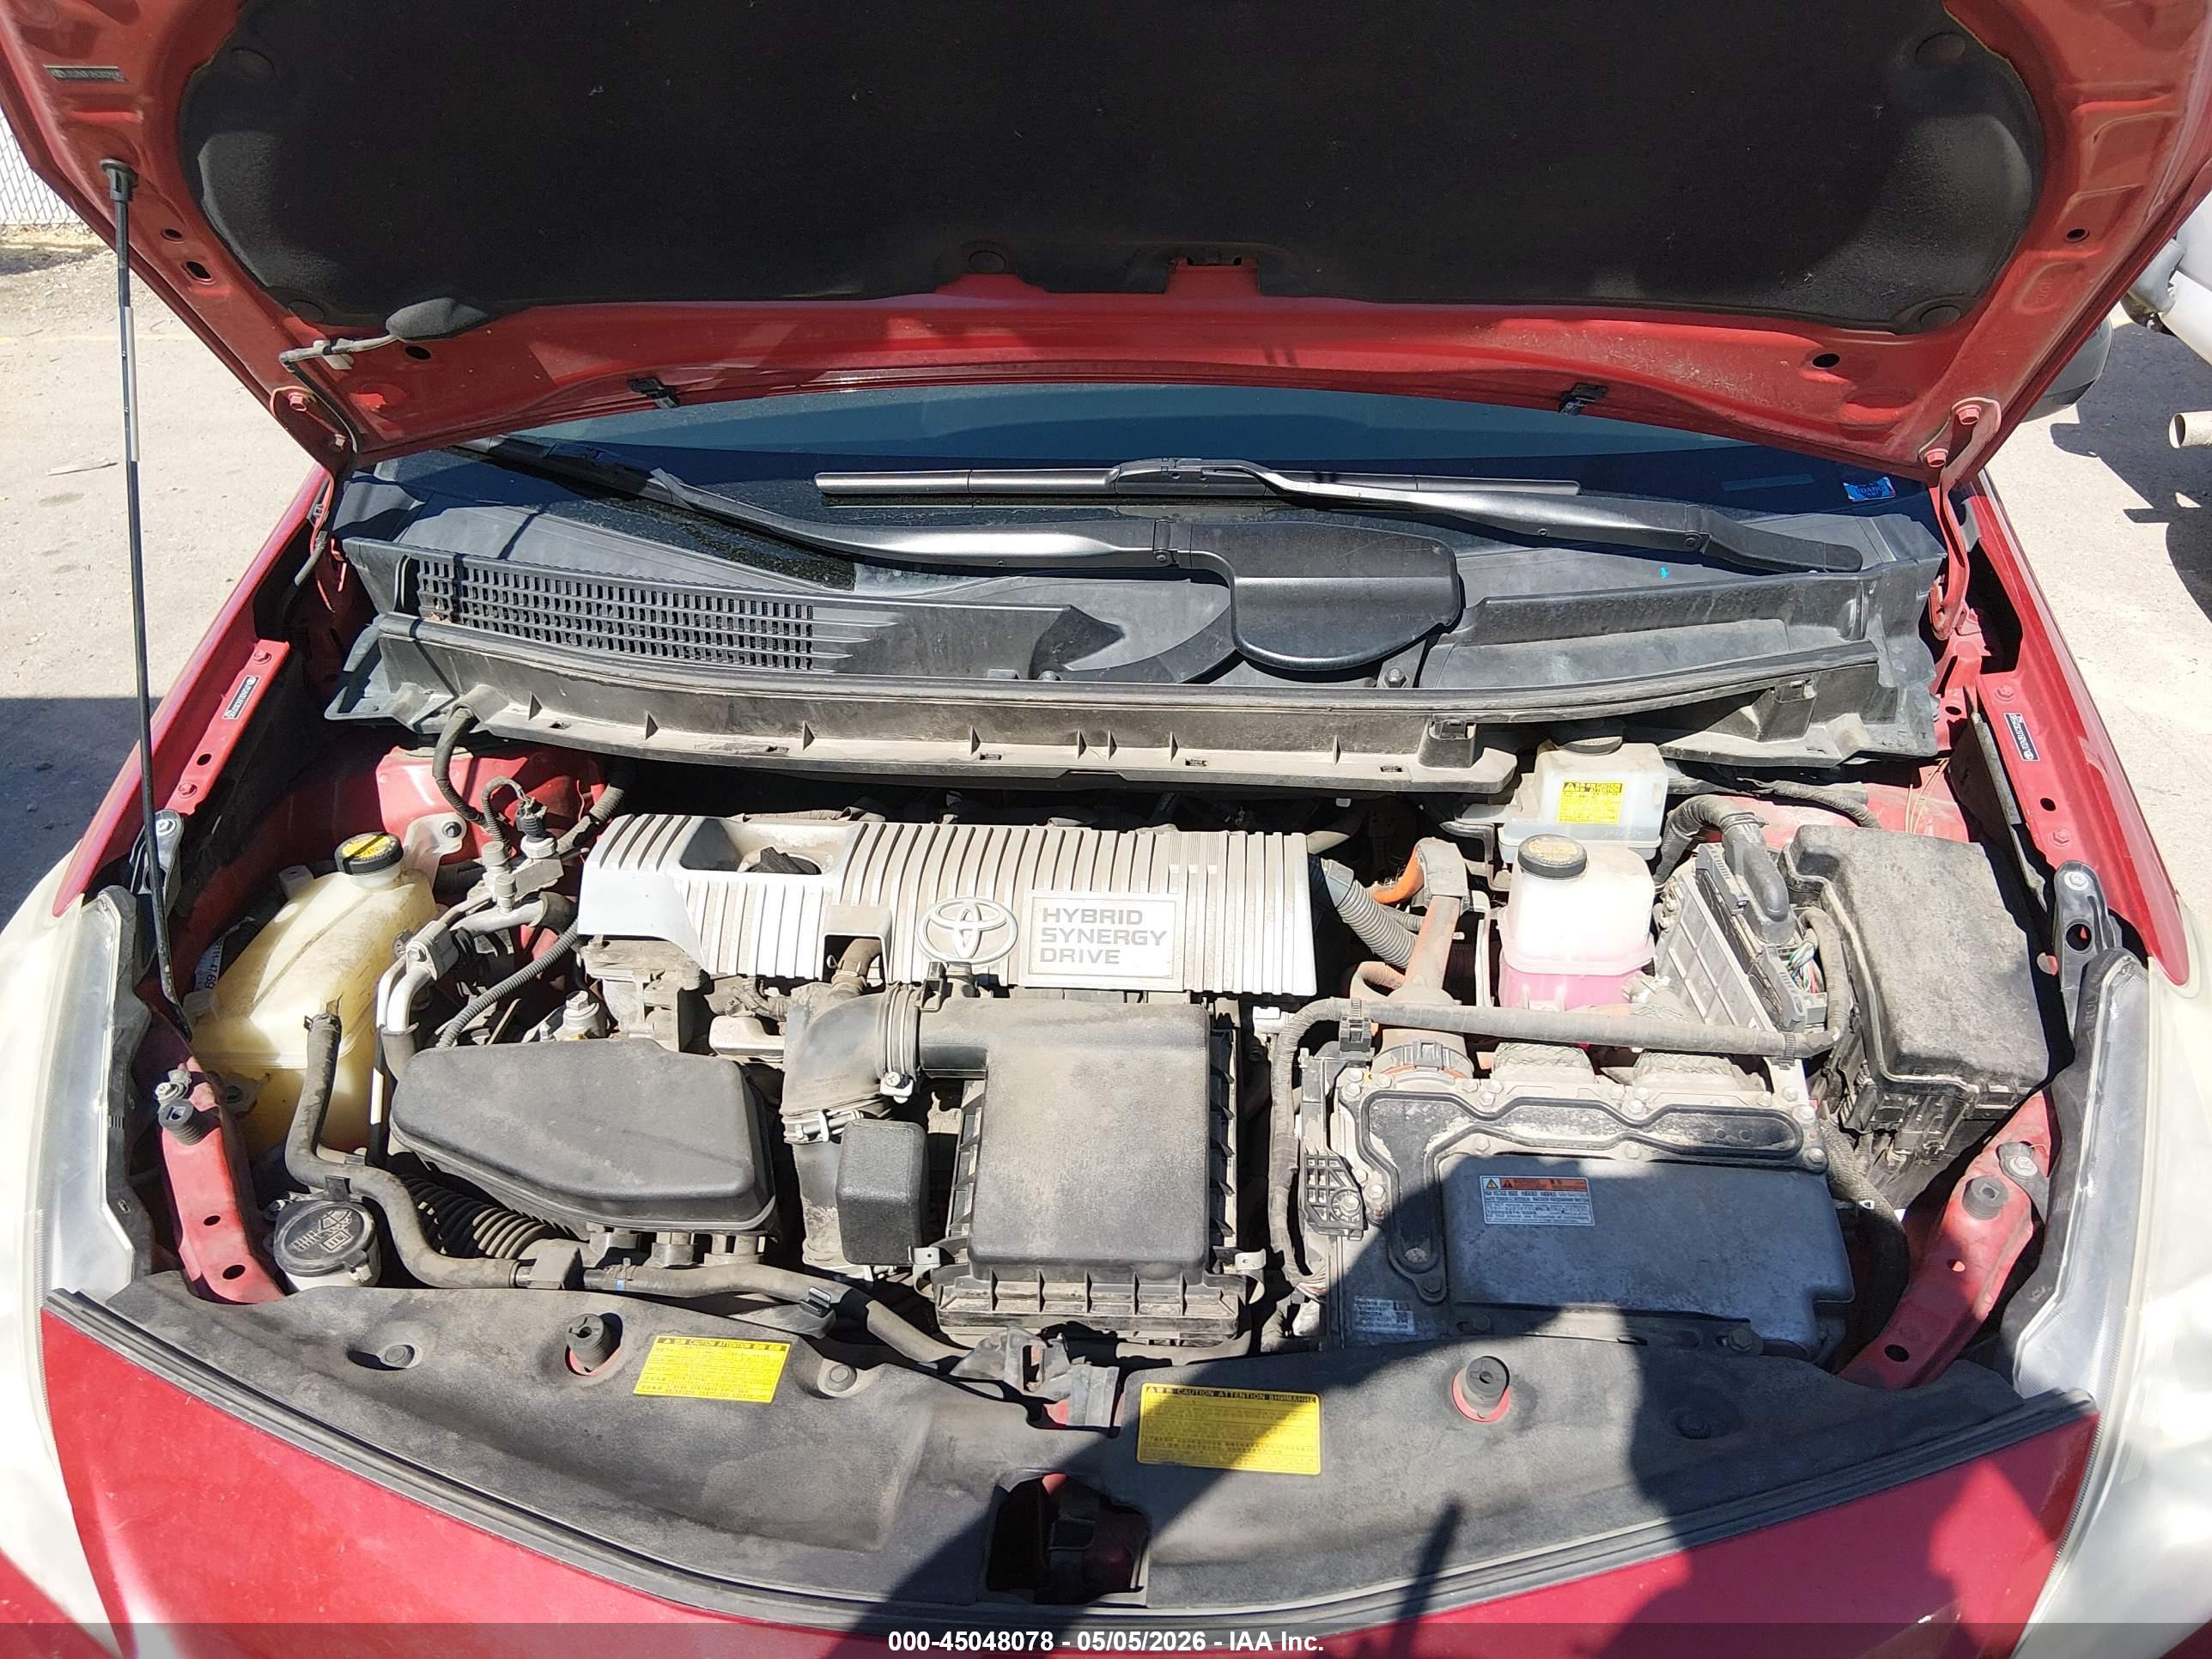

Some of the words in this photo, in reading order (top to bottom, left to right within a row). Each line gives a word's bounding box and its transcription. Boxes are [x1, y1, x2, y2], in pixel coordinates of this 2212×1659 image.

[1042, 908, 1143, 925] HYBRID
[1041, 927, 1167, 946] SYNERGY
[1040, 947, 1121, 964] DRIVE
[204, 975, 217, 989] 69
[1176, 1388, 1214, 1397] CAUTION
[1218, 1390, 1266, 1401] ATTENTION
